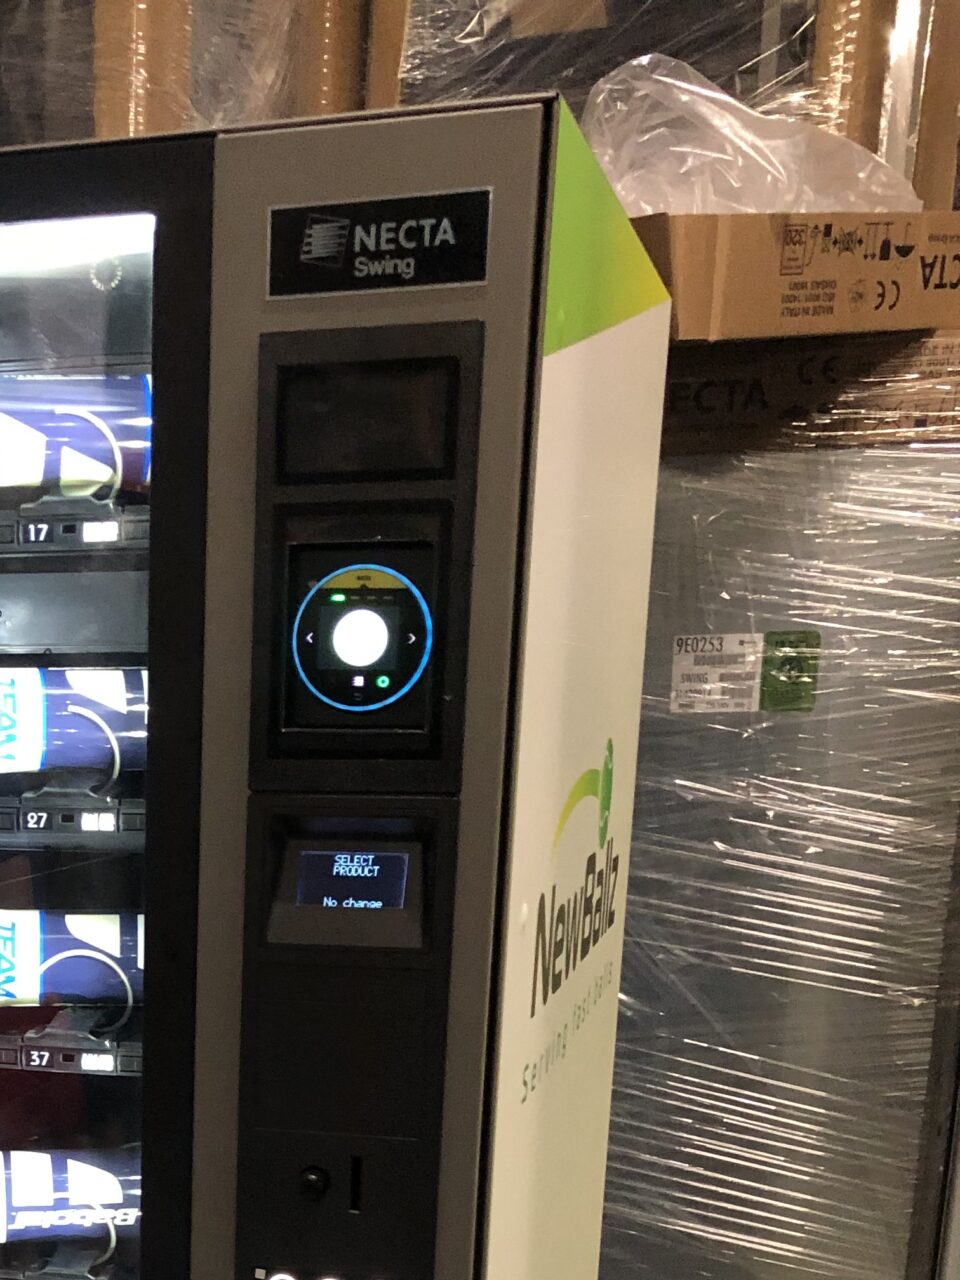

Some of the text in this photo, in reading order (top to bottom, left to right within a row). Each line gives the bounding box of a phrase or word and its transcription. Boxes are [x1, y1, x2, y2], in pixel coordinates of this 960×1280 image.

[353, 216, 457, 253] NECTA
[353, 255, 415, 279] Swing
[28, 523, 49, 542] 17
[676, 636, 724, 654] 9E0253
[680, 672, 709, 684] SWING
[26, 812, 48, 828] 27
[334, 855, 375, 866] SELECT
[332, 865, 381, 877] PRODUCT
[322, 896, 384, 909] No change
[530, 837, 619, 1019] NewBallz
[29, 1050, 50, 1066] 37
[7, 1207, 142, 1230] Babolat
